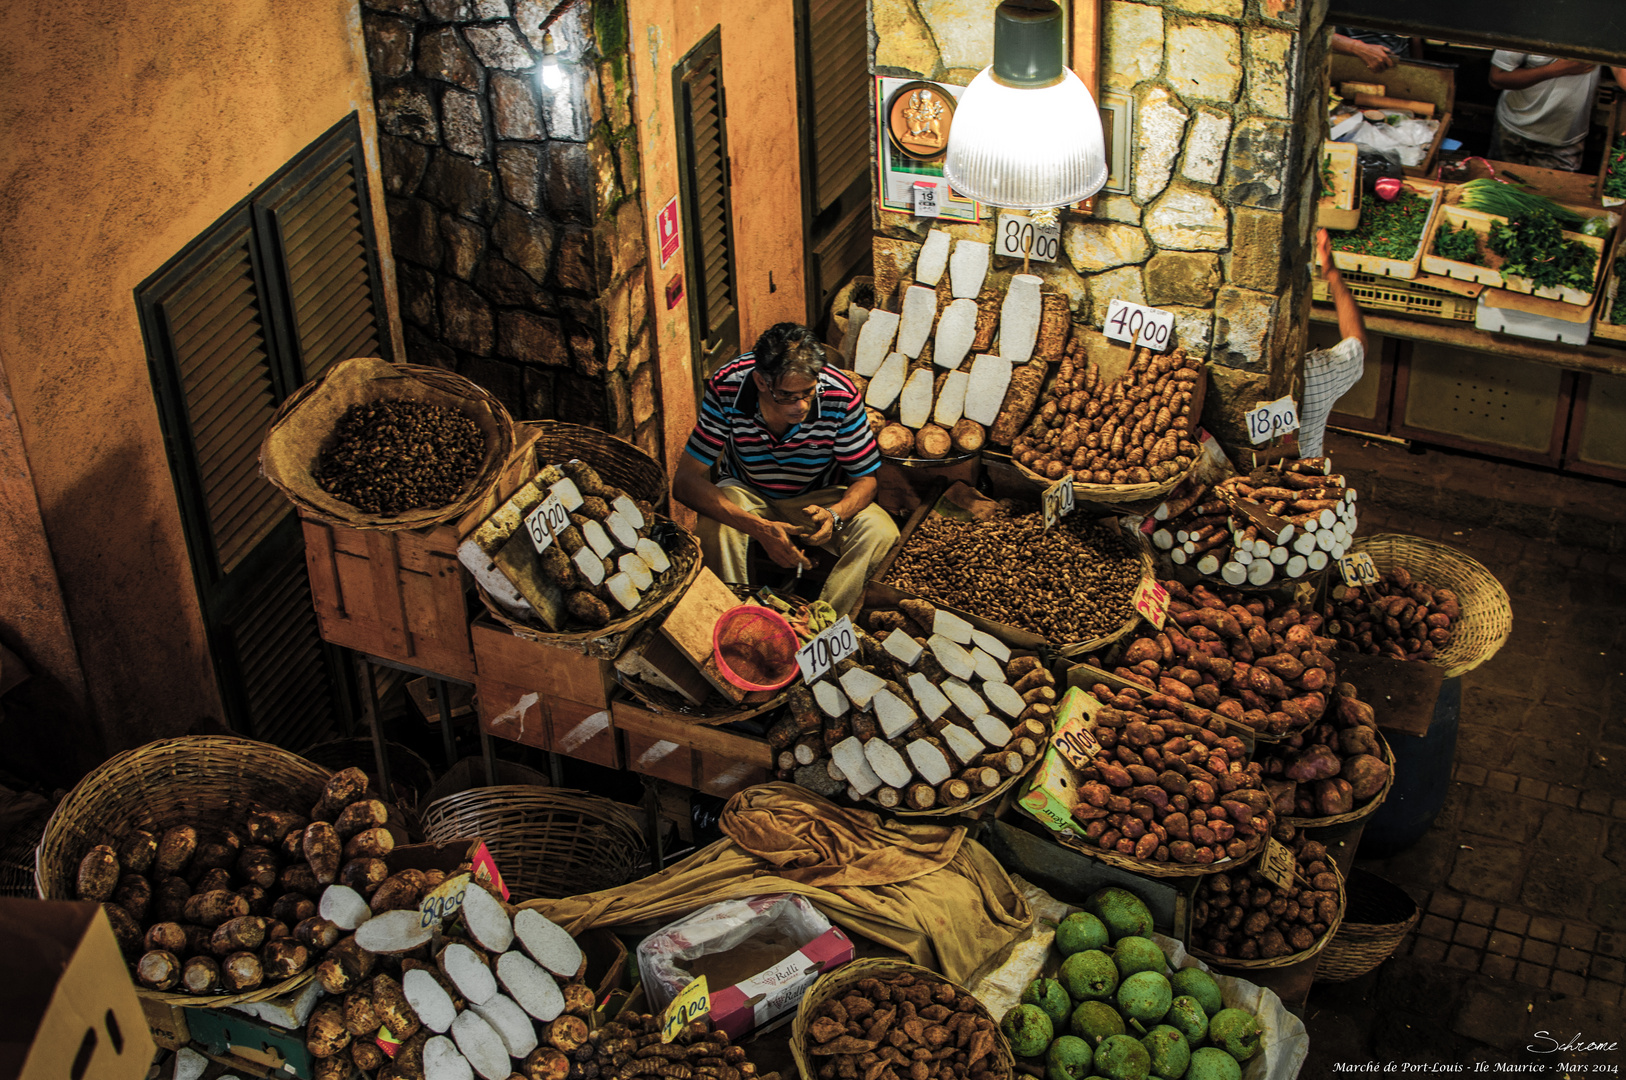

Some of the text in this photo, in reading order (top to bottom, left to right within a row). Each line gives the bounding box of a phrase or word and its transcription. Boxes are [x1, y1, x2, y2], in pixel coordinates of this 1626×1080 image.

[921, 191, 934, 201] 19
[1005, 220, 1058, 259] 80.00
[1251, 408, 1293, 438] 18.00
[775, 963, 799, 981] Ralli
